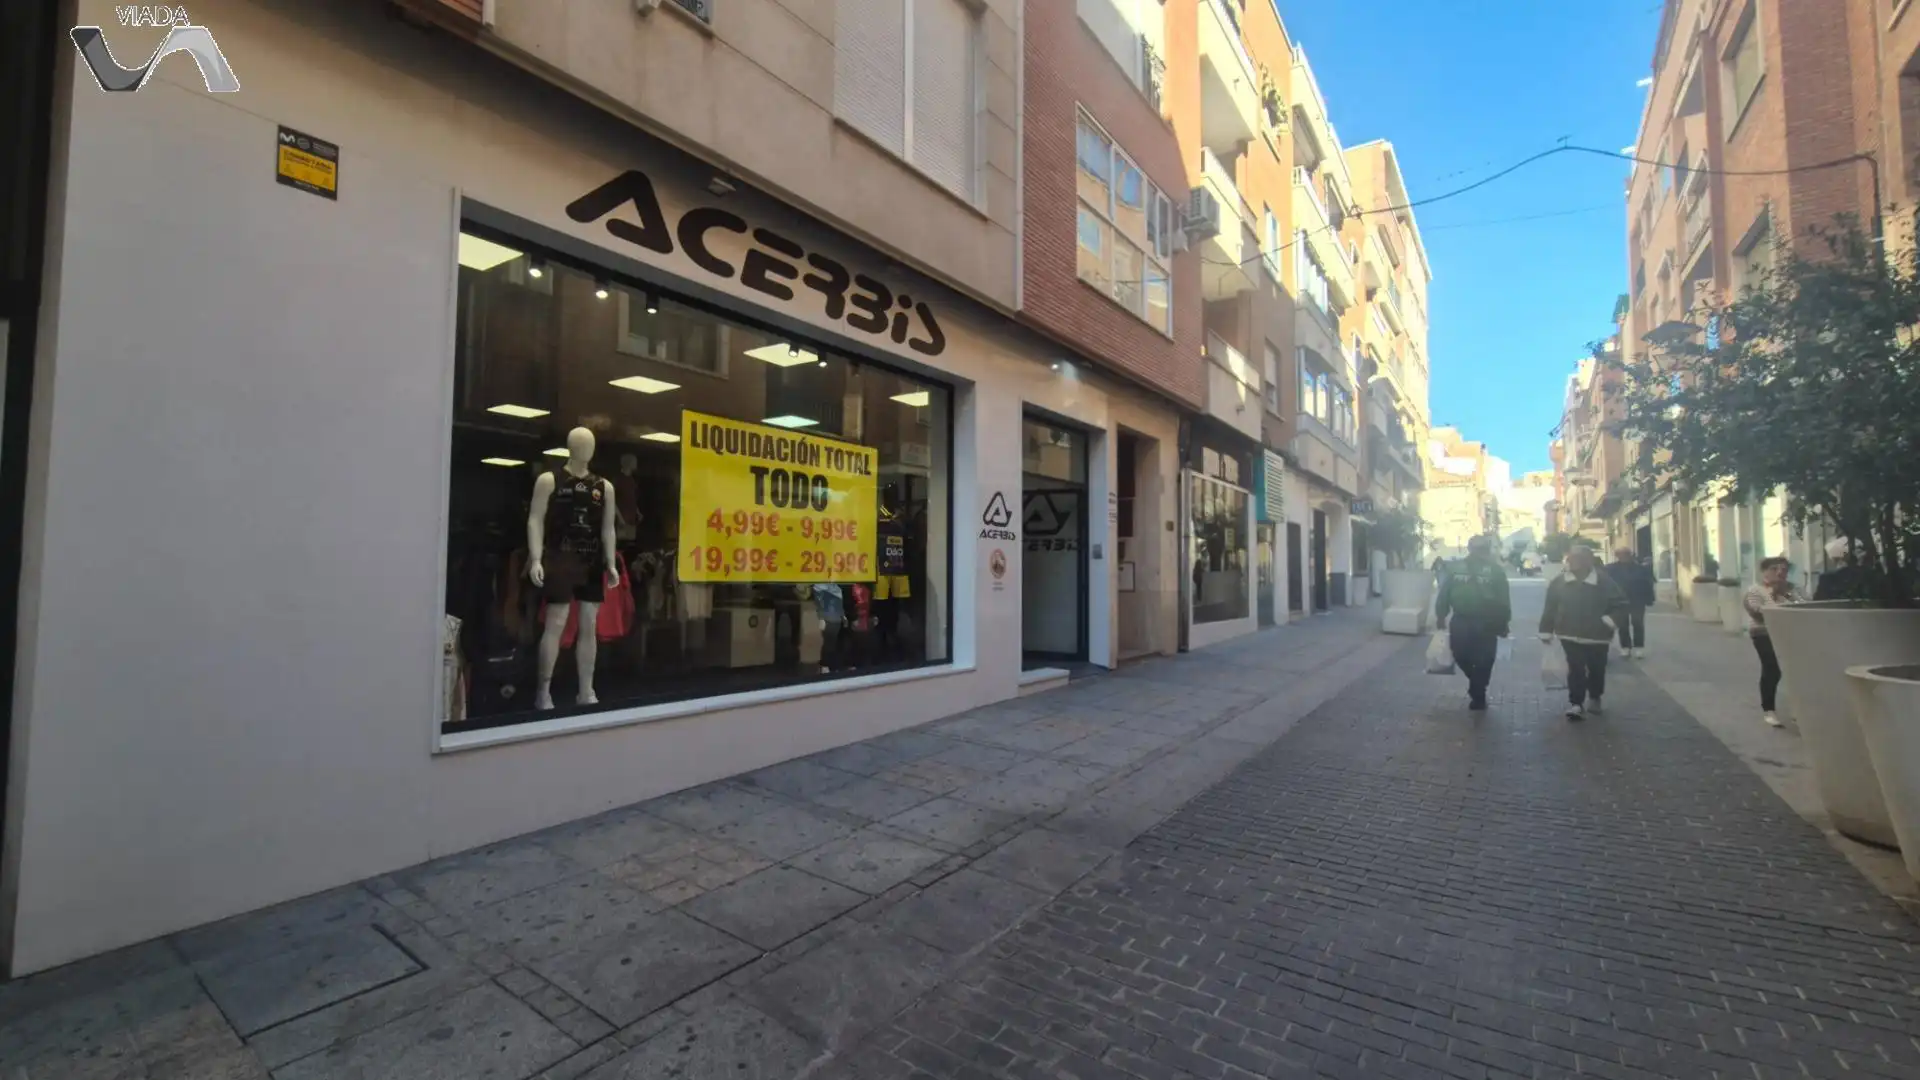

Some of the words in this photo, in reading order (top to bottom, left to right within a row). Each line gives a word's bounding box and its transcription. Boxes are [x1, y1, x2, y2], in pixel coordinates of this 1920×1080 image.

[565, 169, 946, 356] ACERBIS
[690, 420, 821, 468] LIQUIDACIÓN
[824, 445, 872, 476] TOTAL
[750, 465, 829, 512] TODO
[706, 507, 780, 539] 4,99€
[800, 516, 858, 544] 9,99€
[690, 545, 778, 578] 19,99€
[799, 550, 868, 580] 29,99€
